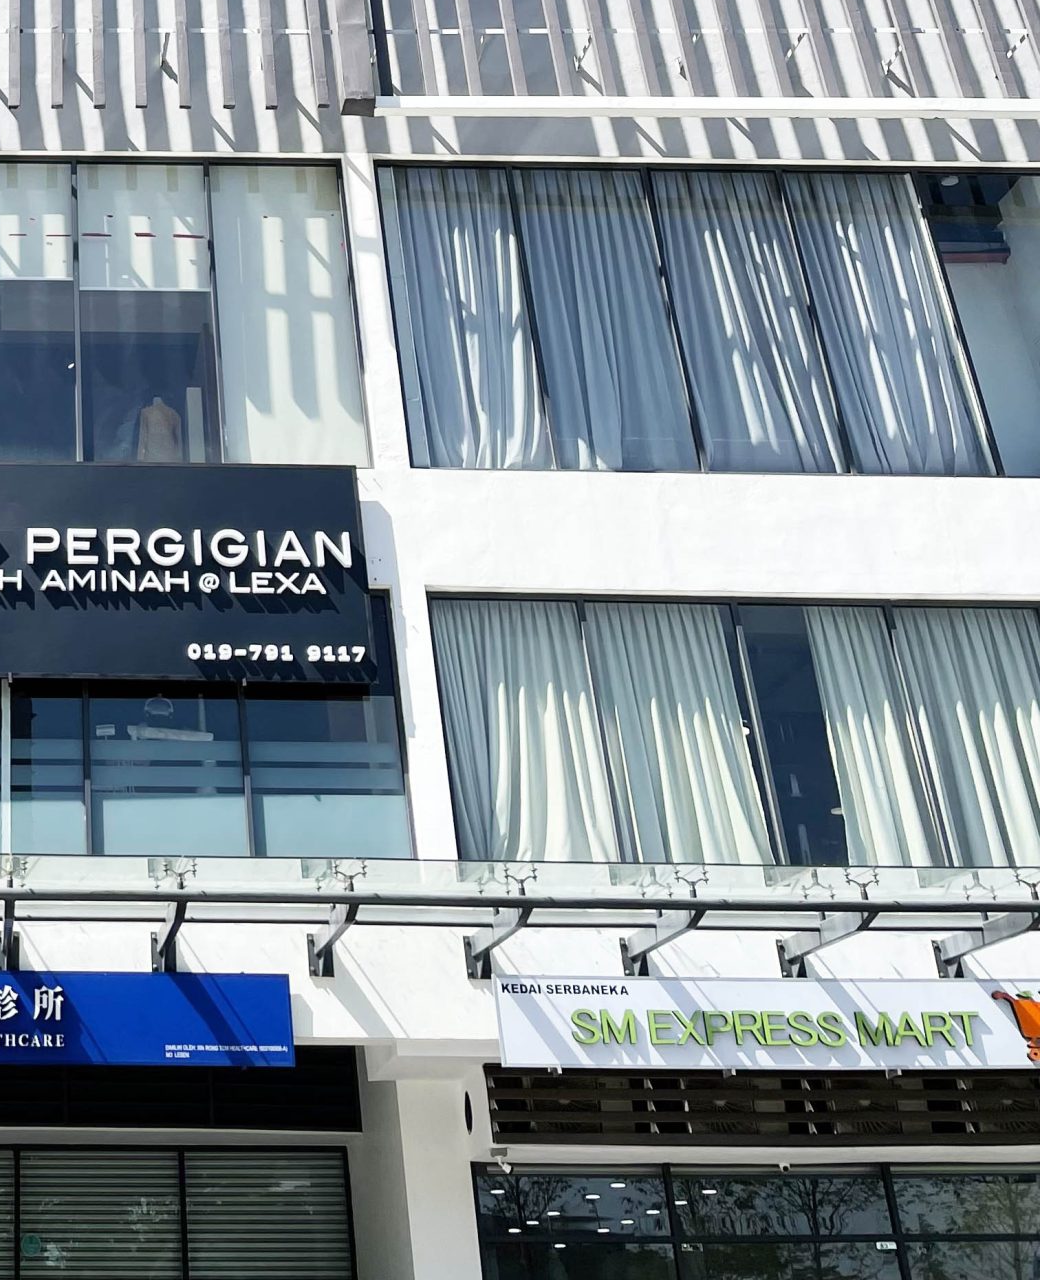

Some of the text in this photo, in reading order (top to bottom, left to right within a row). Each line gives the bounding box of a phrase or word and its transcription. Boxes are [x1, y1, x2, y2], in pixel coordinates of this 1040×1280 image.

[26, 527, 353, 568] PERGIGIAN
[40, 569, 190, 593] AMINAH
[198, 572, 220, 593] @
[229, 571, 327, 595] LEXA
[187, 643, 366, 663] 019-791 9117
[501, 983, 629, 996] KEDAI SERBANEKA
[571, 1008, 979, 1048] SM EXPRESS MART
